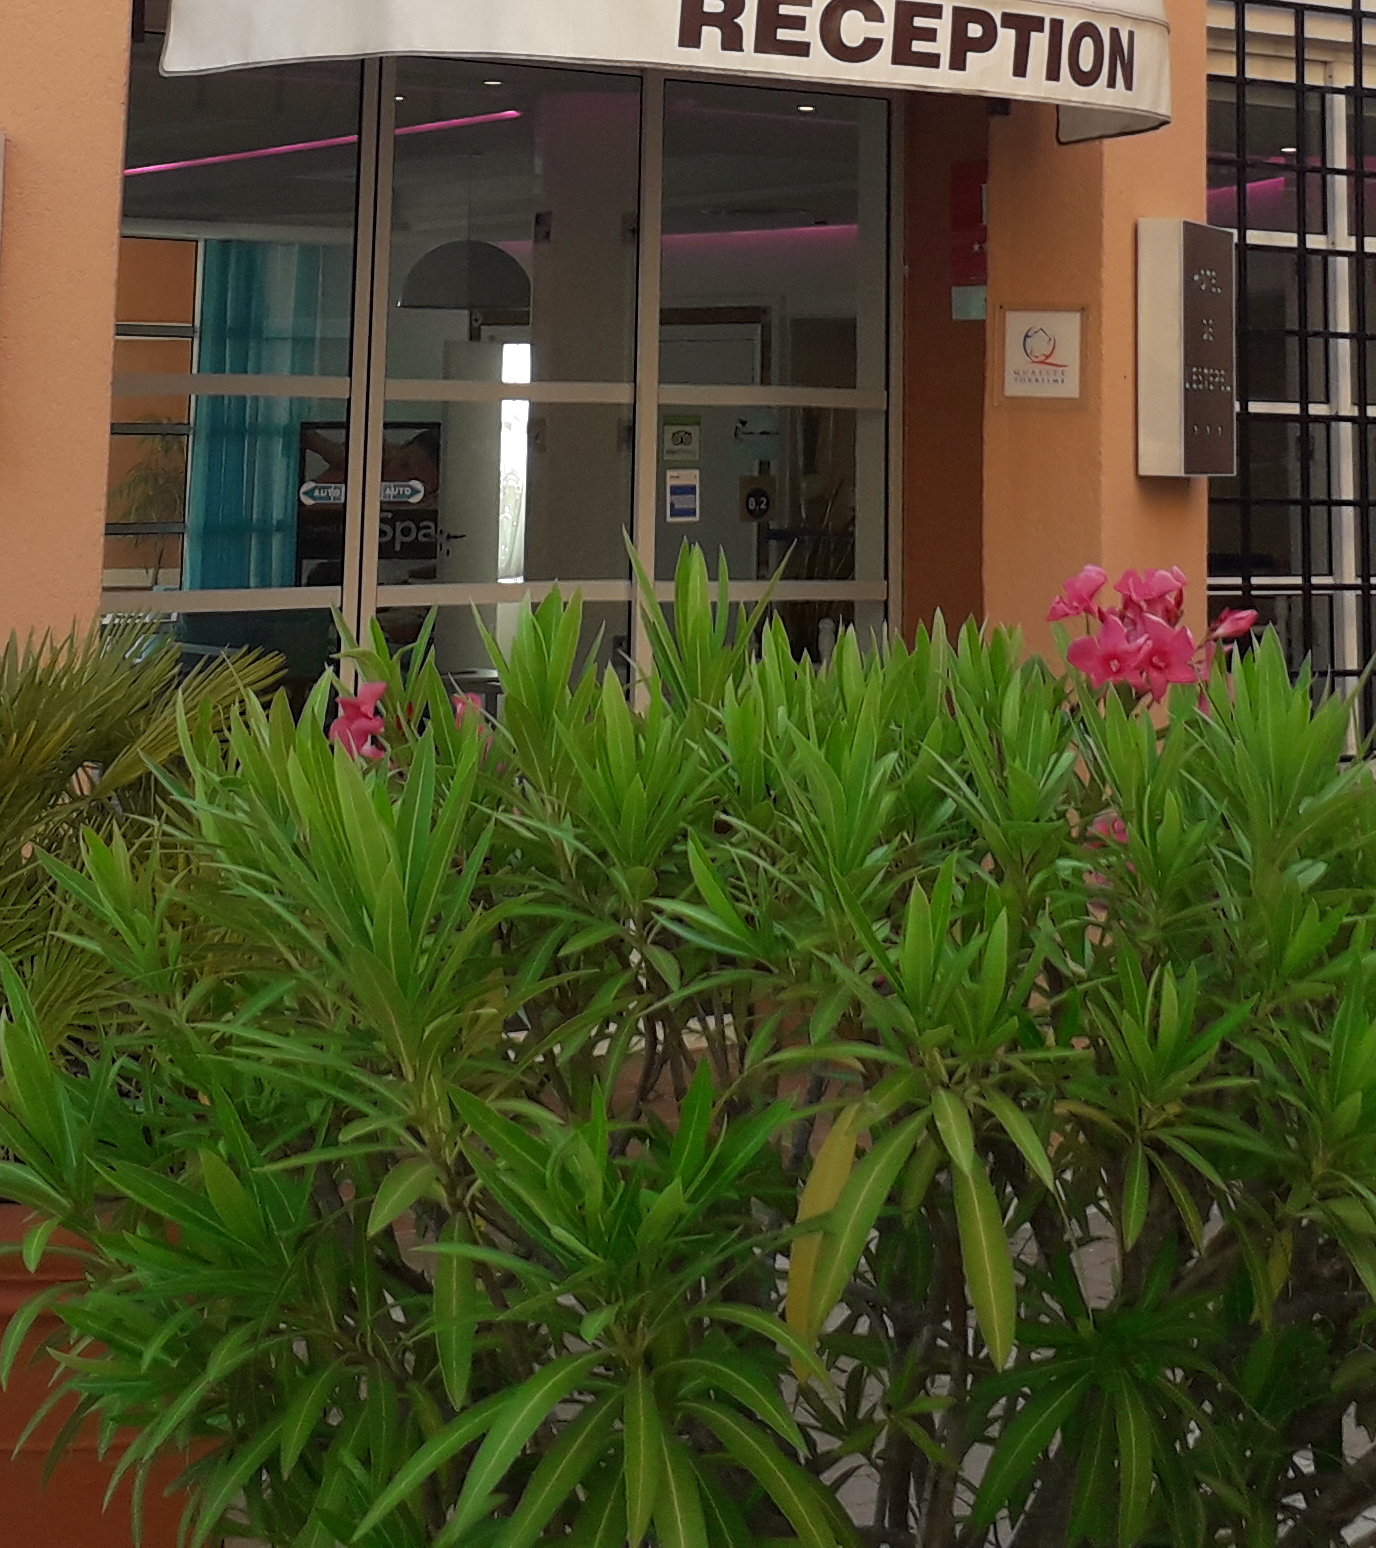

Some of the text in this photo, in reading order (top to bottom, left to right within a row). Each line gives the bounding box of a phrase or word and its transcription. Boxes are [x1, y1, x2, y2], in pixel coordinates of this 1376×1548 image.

[313, 488, 341, 497] AUTO
[385, 487, 412, 495] AUTO
[379, 511, 436, 552] Spa
